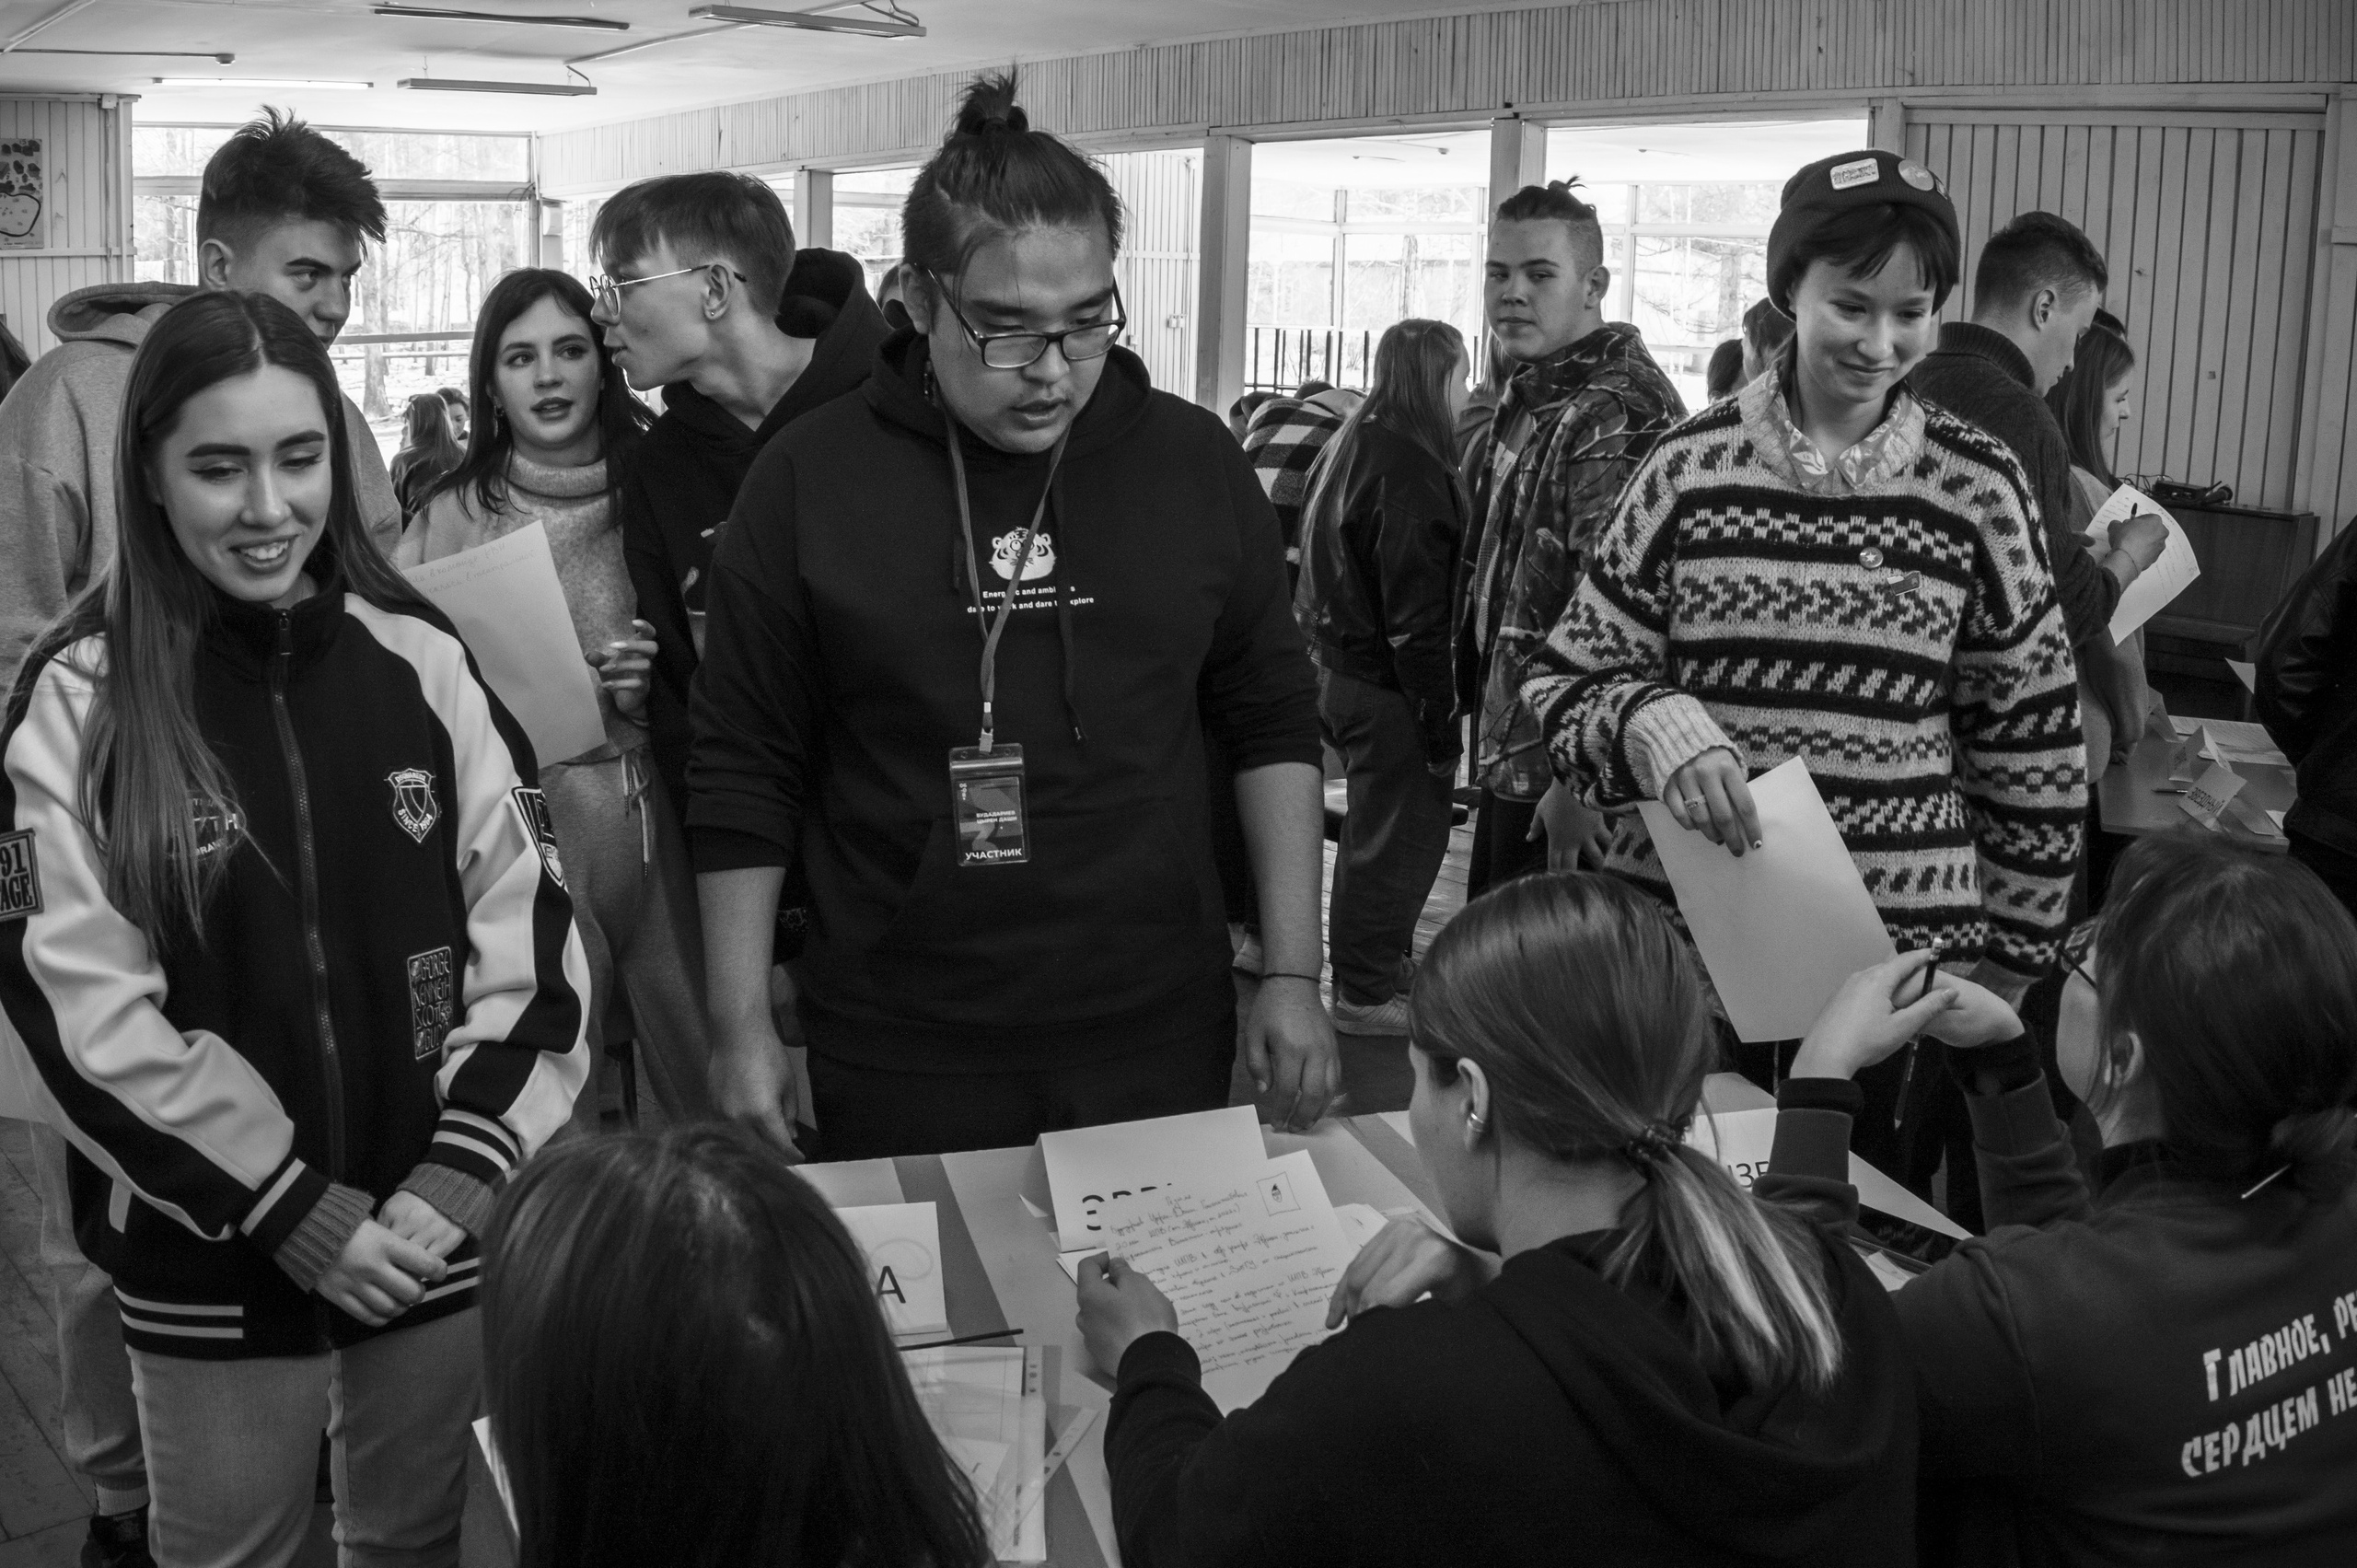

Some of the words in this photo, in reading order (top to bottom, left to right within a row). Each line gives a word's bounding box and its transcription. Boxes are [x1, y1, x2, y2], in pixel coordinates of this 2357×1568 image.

[1022, 587, 1037, 596] and
[967, 605, 985, 614] dae
[987, 604, 996, 612] to
[1018, 601, 1034, 610] and
[1035, 599, 1053, 609] dare
[965, 848, 1023, 861] УЧАСТНИК
[2202, 1314, 2331, 1402] ГЛАВНОЕ,
[2333, 1290, 2357, 1340] РЕ
[2181, 1386, 2320, 1479] СЕРДЦЕМ
[2327, 1366, 2357, 1417] НЕ
